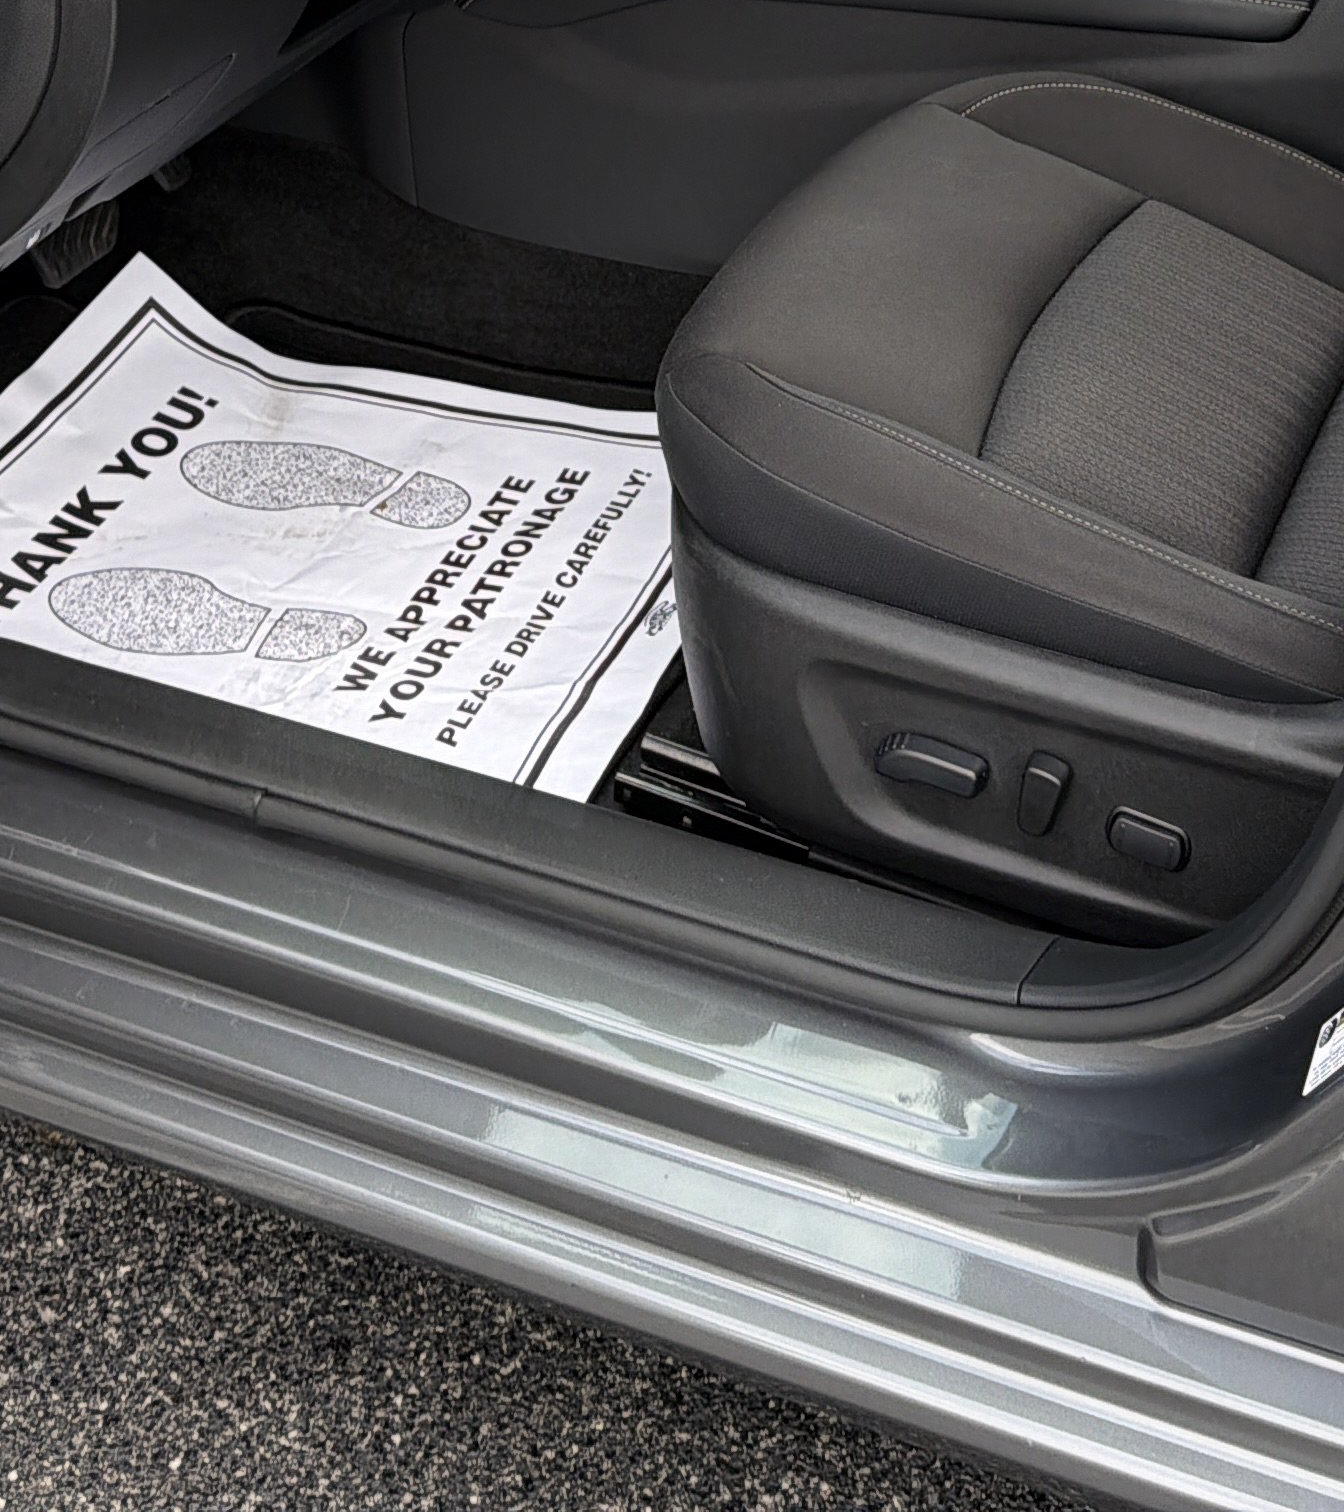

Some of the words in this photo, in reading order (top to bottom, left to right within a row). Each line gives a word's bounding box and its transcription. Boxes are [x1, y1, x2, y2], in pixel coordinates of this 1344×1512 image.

[97, 386, 220, 480] YOU!
[334, 646, 397, 692] WE
[384, 475, 536, 643] APPRECIATE
[367, 638, 463, 723] YOUR
[444, 467, 591, 633] PATRONAGE
[435, 659, 516, 748] PLEASE
[505, 590, 567, 658] DRIVE
[555, 468, 653, 589] CAREFULLY!
